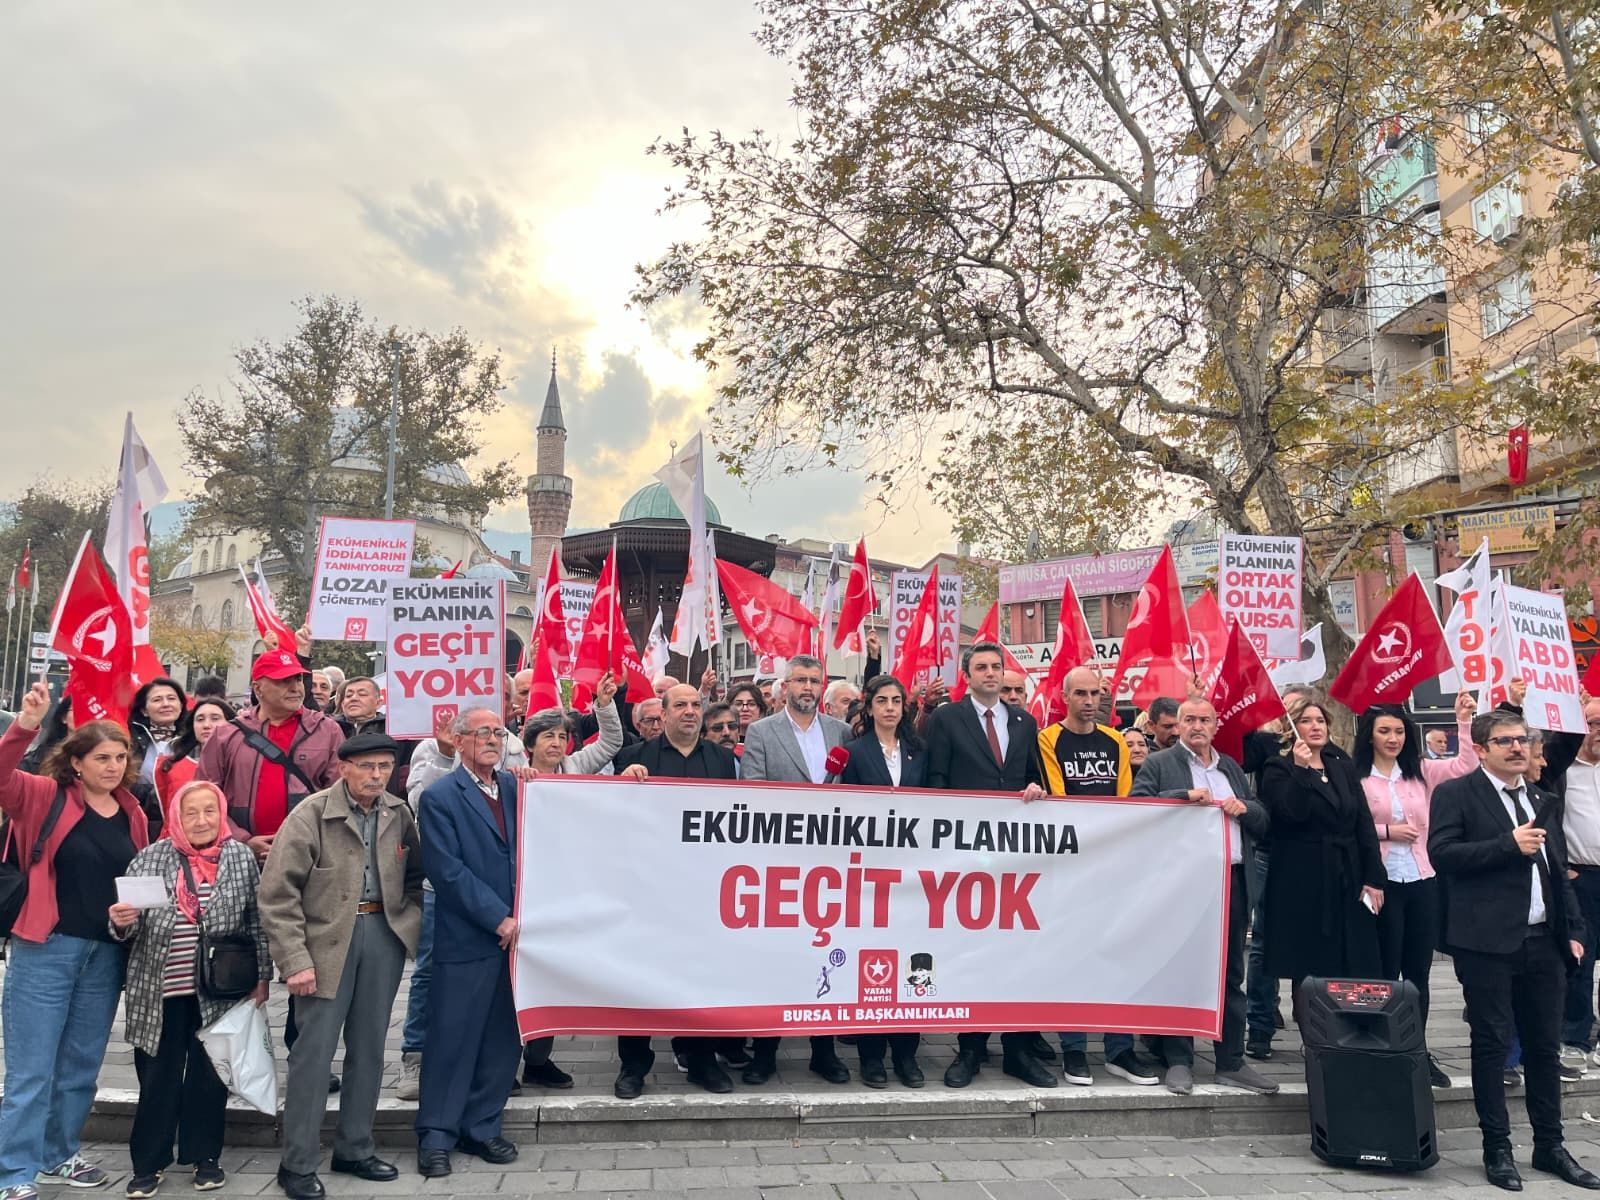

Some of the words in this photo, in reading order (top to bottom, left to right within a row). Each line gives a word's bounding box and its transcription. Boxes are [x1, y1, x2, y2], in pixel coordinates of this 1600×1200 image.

[328, 537, 408, 549] EKÜMENİKLİK
[1226, 539, 1296, 554] EKÜMENİK
[326, 547, 406, 560] İDDİALARINI
[324, 562, 404, 572] TANIMIYORUZ!
[1226, 556, 1296, 570] PLANINA
[1017, 570, 1048, 583] MUSA
[1050, 562, 1106, 582] ÇALIŞKAN
[1225, 571, 1295, 589] ORTAK
[319, 594, 386, 606] ÇİĞNETMEY
[392, 582, 494, 600] EKÜMENİK
[1225, 590, 1295, 610] OLMA
[393, 606, 494, 622] PLANINA
[1508, 601, 1562, 620] EKÜMENİKLİK
[1512, 616, 1566, 641] YALANI
[394, 624, 495, 664] GEÇİT
[1518, 638, 1570, 669] ABD
[394, 668, 495, 698] YOK!
[1522, 666, 1576, 695] PLANI
[1064, 760, 1118, 778] BLACK
[681, 803, 920, 850] EKÜMENİKLİK
[932, 818, 1080, 856] PLANINA
[719, 851, 902, 948] GEÇİT
[918, 870, 1042, 932] YOK
[864, 988, 892, 996] VATAN
[904, 984, 937, 997] TGB
[783, 1008, 832, 1022] BURSA
[838, 1006, 850, 1021] İL
[855, 1007, 970, 1023] BAŞKANLIKLARI
